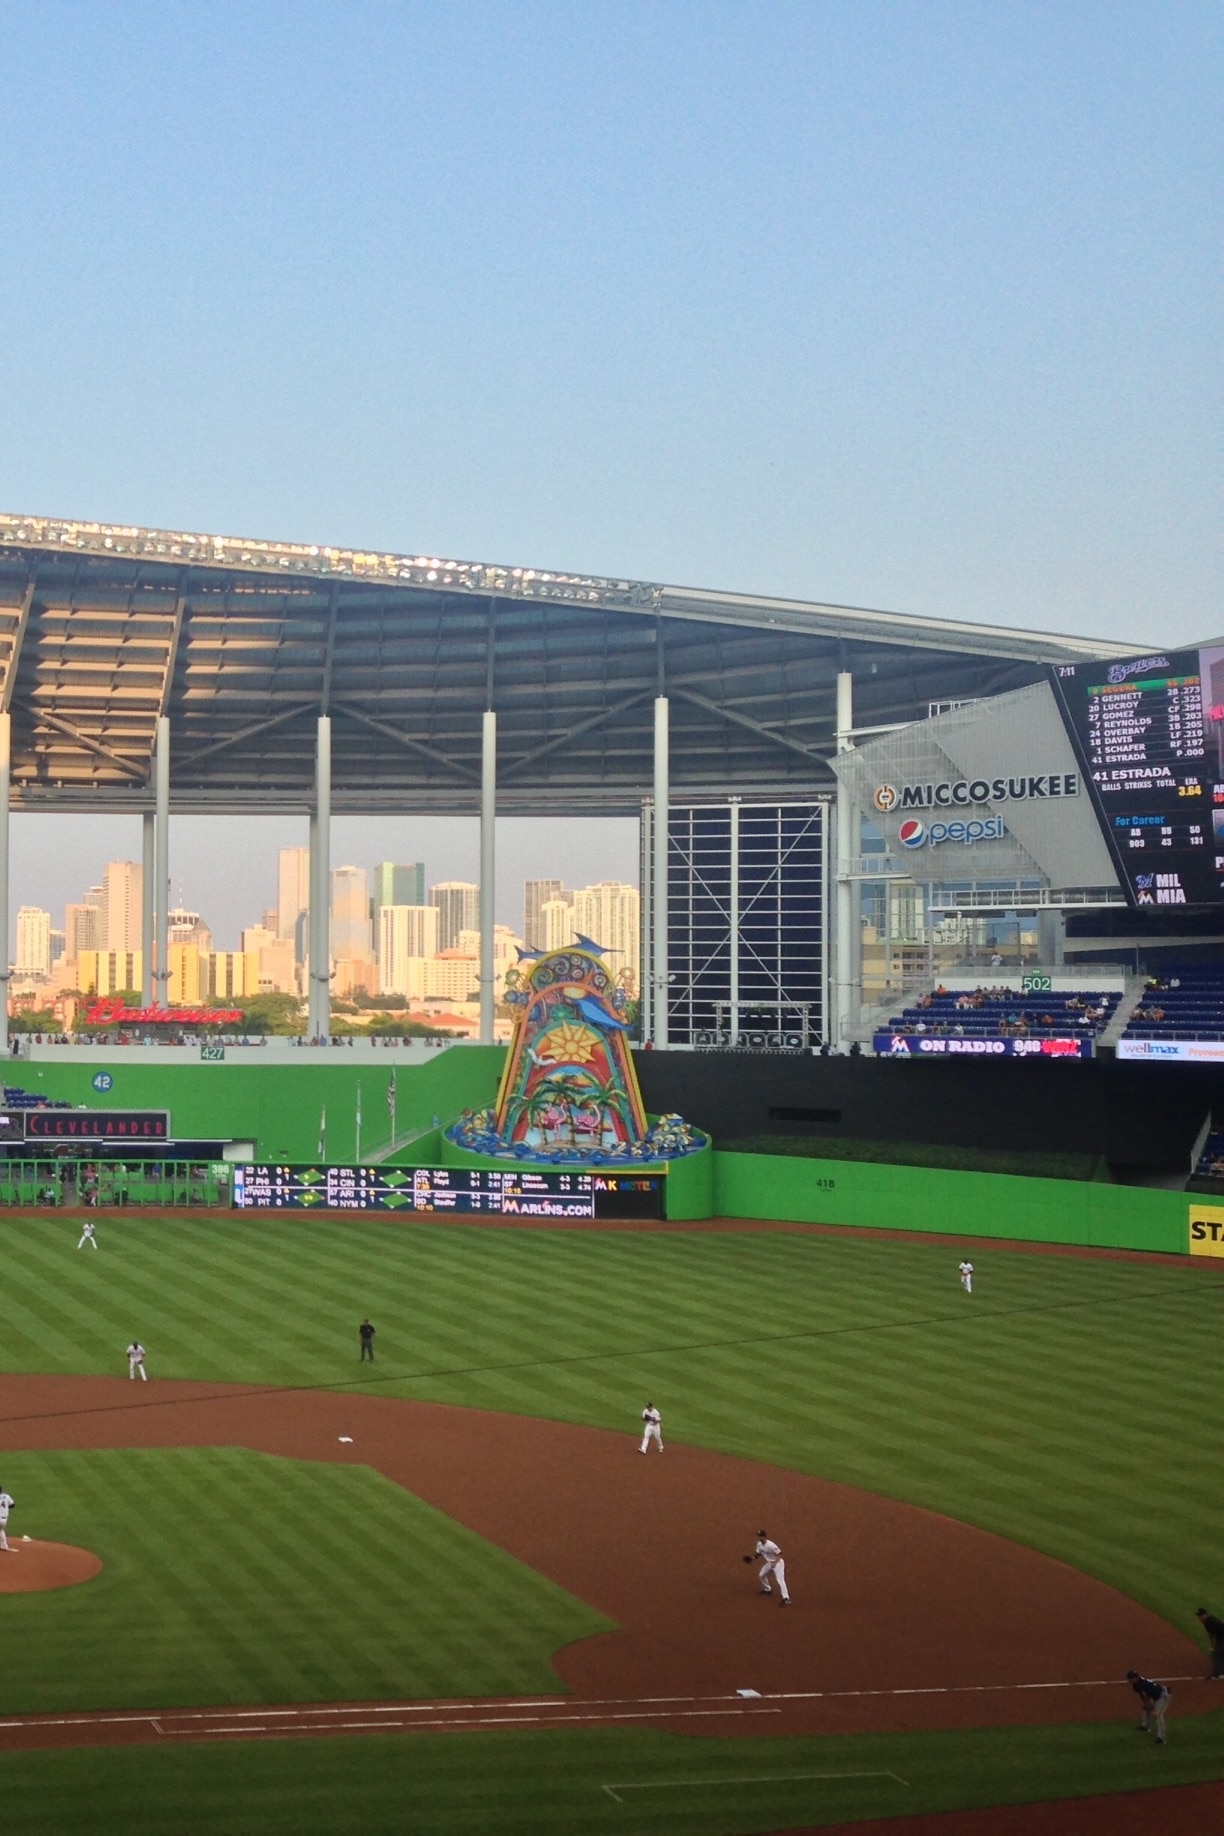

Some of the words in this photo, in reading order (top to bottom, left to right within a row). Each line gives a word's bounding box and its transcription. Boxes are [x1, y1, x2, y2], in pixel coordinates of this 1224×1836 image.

[1059, 666, 1075, 677] 7:11
[1108, 656, 1170, 683] Brewers
[1102, 692, 1143, 703] GENNETT
[1180, 686, 1200, 695] .273
[1103, 701, 1139, 711] LUCROY
[1181, 695, 1201, 704] .323
[1102, 711, 1135, 720] GOMEZ
[1090, 730, 1101, 738] 24
[1103, 727, 1147, 737] OVERBAY
[1169, 723, 1181, 731] 1B
[1183, 721, 1203, 729] .205
[1104, 718, 1152, 729] REYNOLDS
[1104, 736, 1133, 745] DAVIS
[1183, 730, 1203, 738] .219
[1104, 744, 1146, 754] SCHAFER
[1184, 739, 1204, 747] .197
[1105, 753, 1147, 763] ESTRADA
[1184, 748, 1205, 757] .000
[1093, 771, 1108, 781] 41
[1112, 766, 1172, 780] ESTRADA
[901, 774, 1076, 807] MICCOSUKEE
[1101, 783, 1121, 792] BALLS
[1124, 780, 1153, 790] STRIKES
[1156, 778, 1177, 787] TOTAL
[1178, 785, 1202, 797] 3.64
[1132, 816, 1165, 825] Career
[929, 815, 1003, 845] pepsi
[1161, 838, 1172, 846] 43
[1190, 837, 1204, 845] 131
[1156, 874, 1181, 888] MIL
[1156, 889, 1186, 904] MIA
[1024, 978, 1050, 990] 502
[83, 997, 243, 1025] Budweiser
[202, 1047, 223, 1059] 427
[920, 1039, 946, 1052] ON
[948, 1040, 1005, 1054] RADIO
[1124, 1043, 1179, 1054] wellmax
[94, 1076, 110, 1088] 42
[30, 1115, 163, 1134] CLEVELANDER
[258, 1167, 268, 1175] LA
[340, 1169, 355, 1177] STL
[340, 1179, 355, 1187] CIN
[608, 1180, 617, 1190] K
[816, 1179, 835, 1188] 418
[340, 1200, 358, 1208] NYM
[502, 1199, 591, 1216] MARLINS.COM
